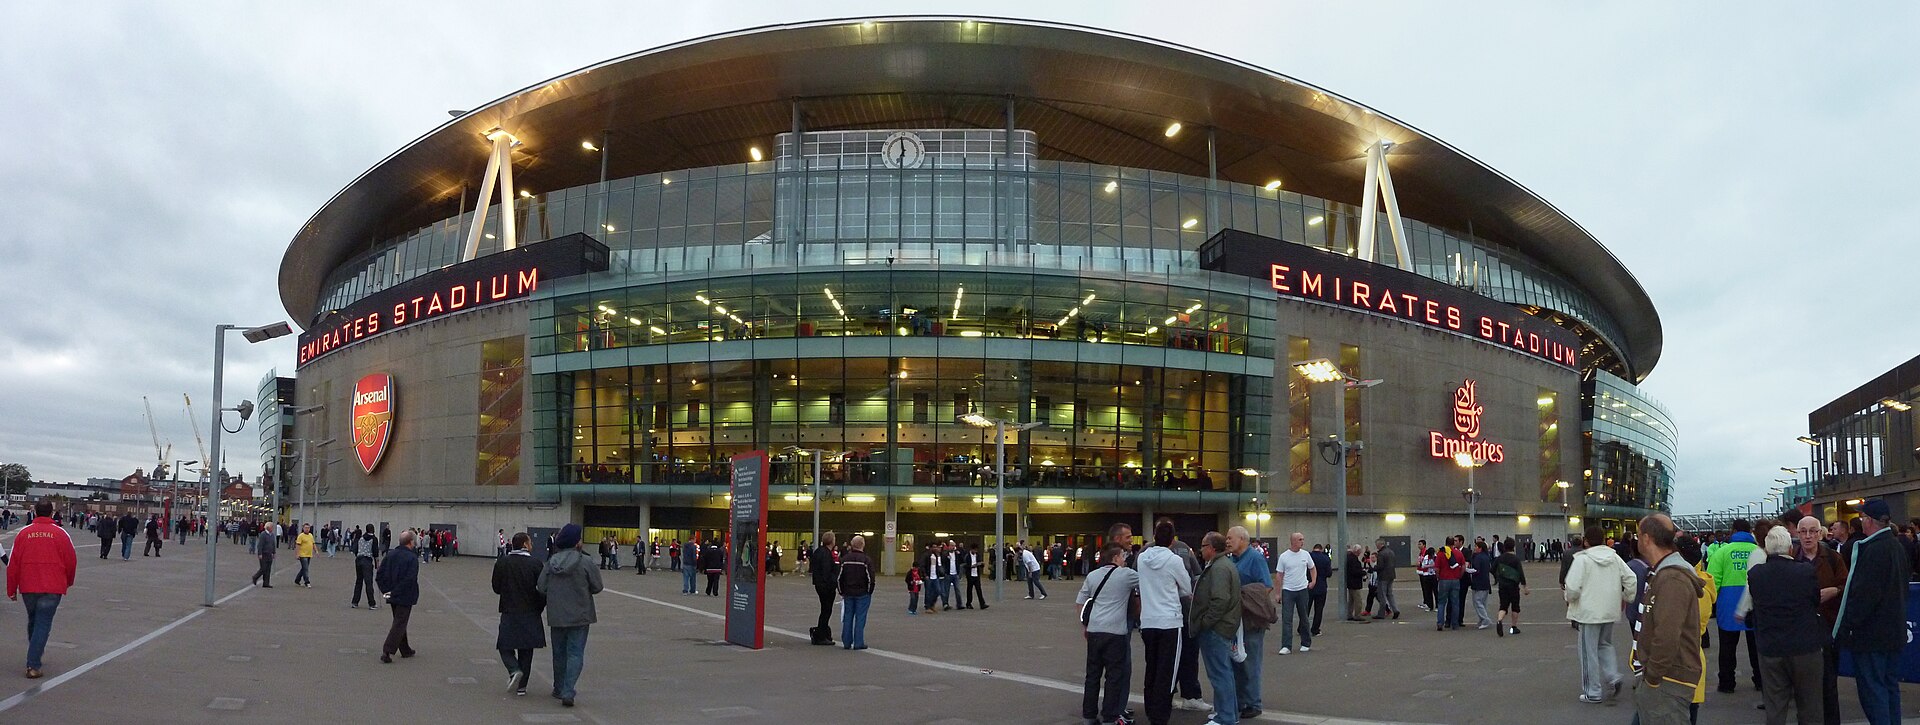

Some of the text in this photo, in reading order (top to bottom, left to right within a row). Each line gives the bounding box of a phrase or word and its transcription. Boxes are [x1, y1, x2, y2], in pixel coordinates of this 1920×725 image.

[300, 267, 538, 364] EMIRATES STADIUM
[1271, 263, 1576, 367] EMIRATES STADIUM
[354, 385, 387, 406] Arsenal
[1430, 431, 1504, 463] Emirates
[27, 531, 54, 539] ARSENAL
[1733, 561, 1748, 571] TEA
